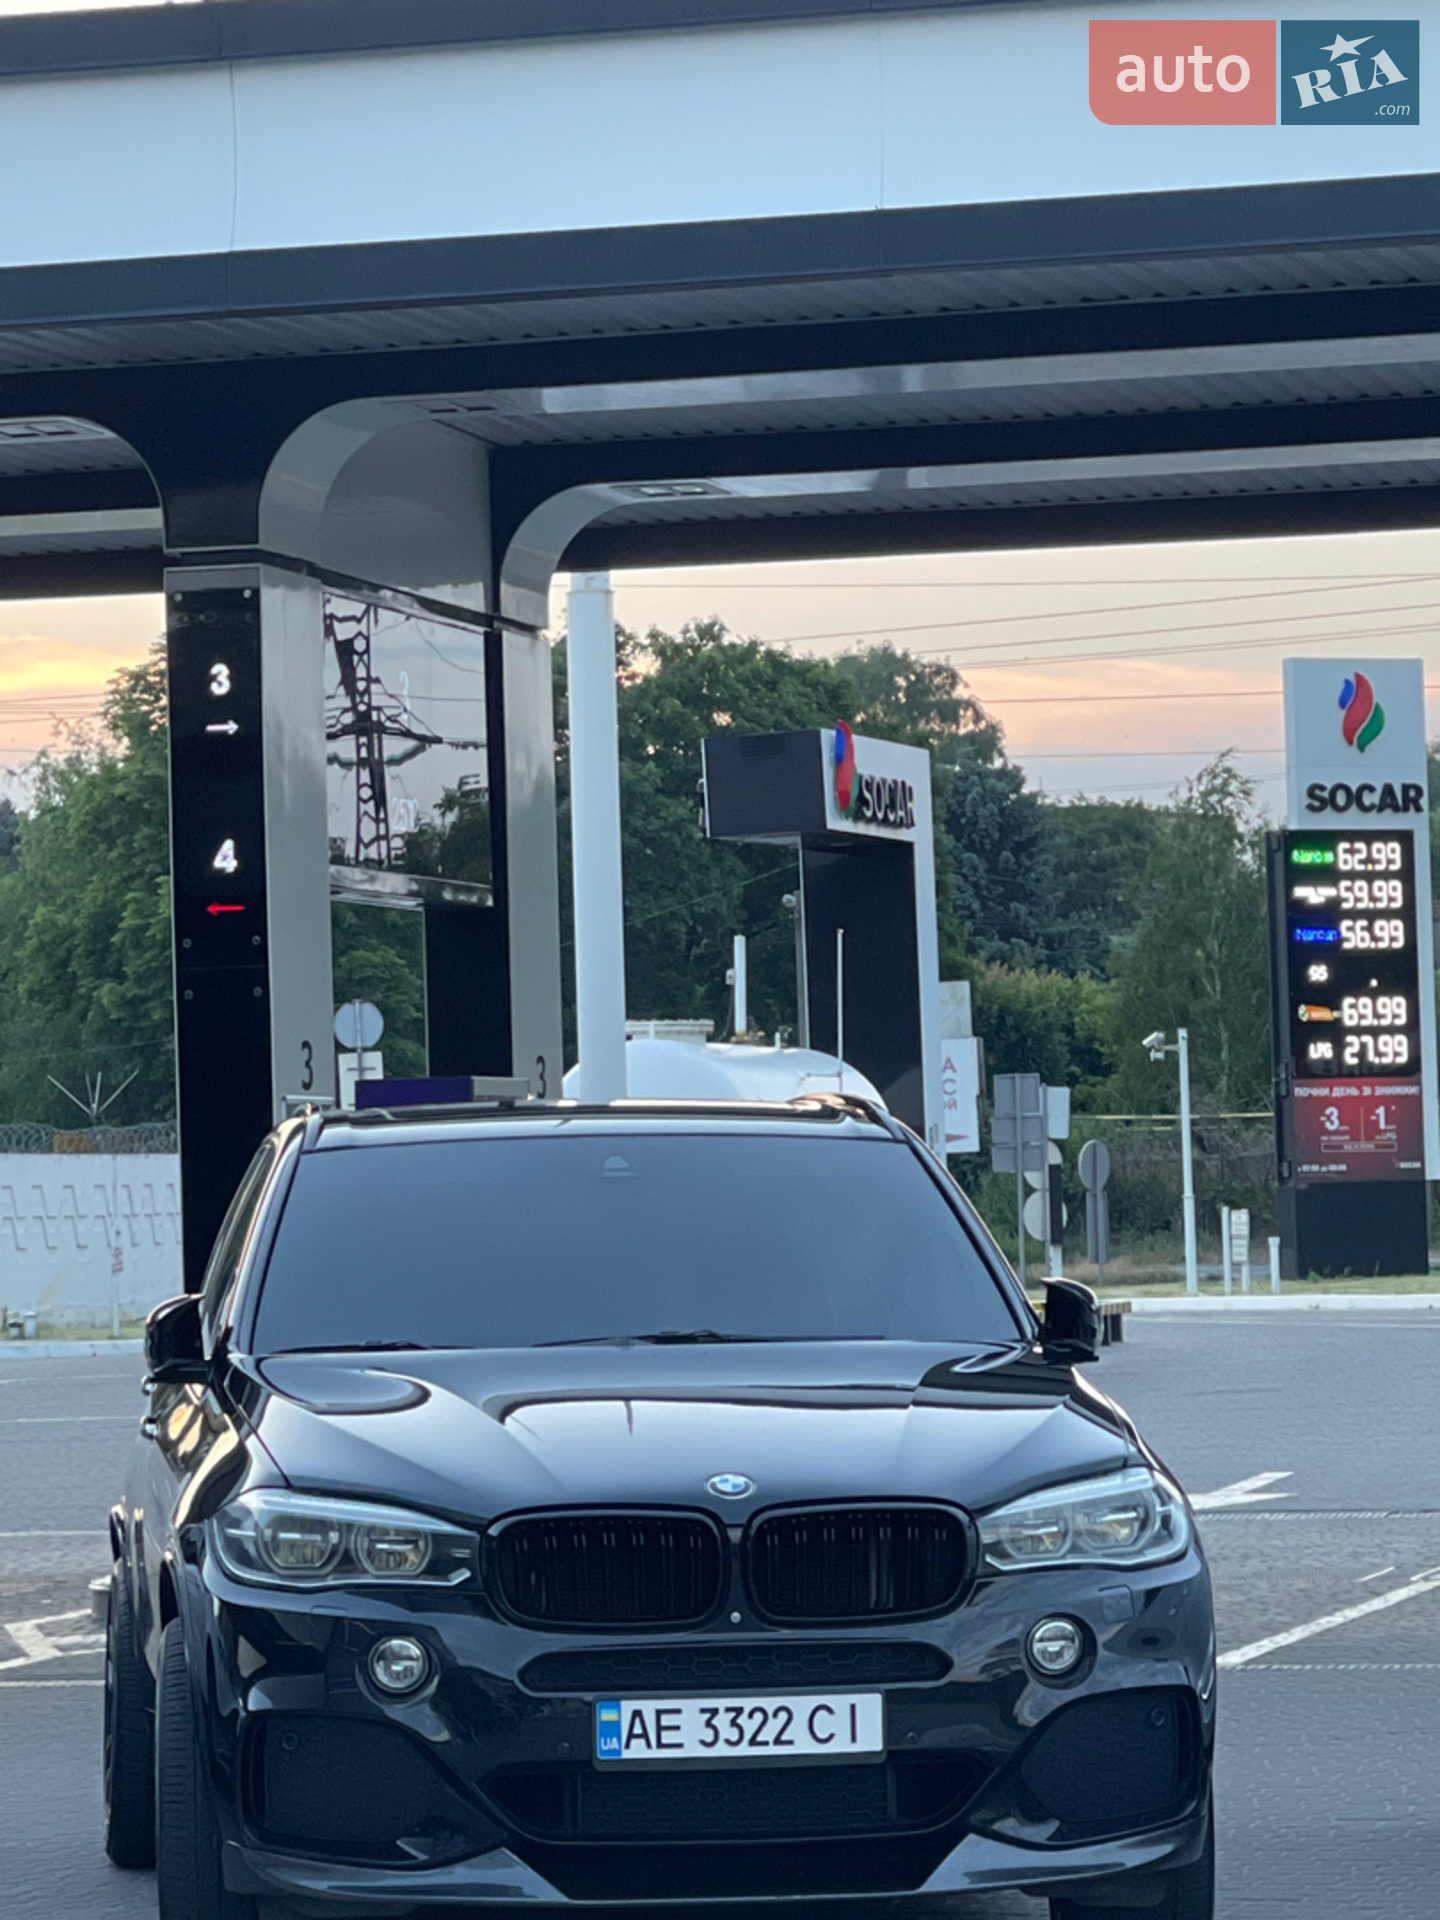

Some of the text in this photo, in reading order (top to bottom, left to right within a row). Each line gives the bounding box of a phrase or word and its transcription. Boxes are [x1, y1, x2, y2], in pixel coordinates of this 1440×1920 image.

[210, 663, 230, 695] 3
[861, 774, 915, 828] SOCAR
[1306, 782, 1424, 813] SOCAR
[213, 839, 238, 873] 4
[1337, 842, 1402, 871] 62.99
[1339, 880, 1403, 909] 59.99
[1340, 919, 1405, 949] 56.99
[1308, 965, 1328, 982] 95
[1342, 996, 1407, 1026] 69.99
[1309, 1042, 1333, 1059] LPG
[1344, 1034, 1408, 1064] 27.99
[301, 1040, 313, 1091] 3
[536, 1055, 547, 1099] 3
[1332, 1086, 1360, 1098] ДЕНЬ
[624, 1708, 684, 1750] AE
[698, 1705, 795, 1748] 3322
[600, 1737, 619, 1750] UA
